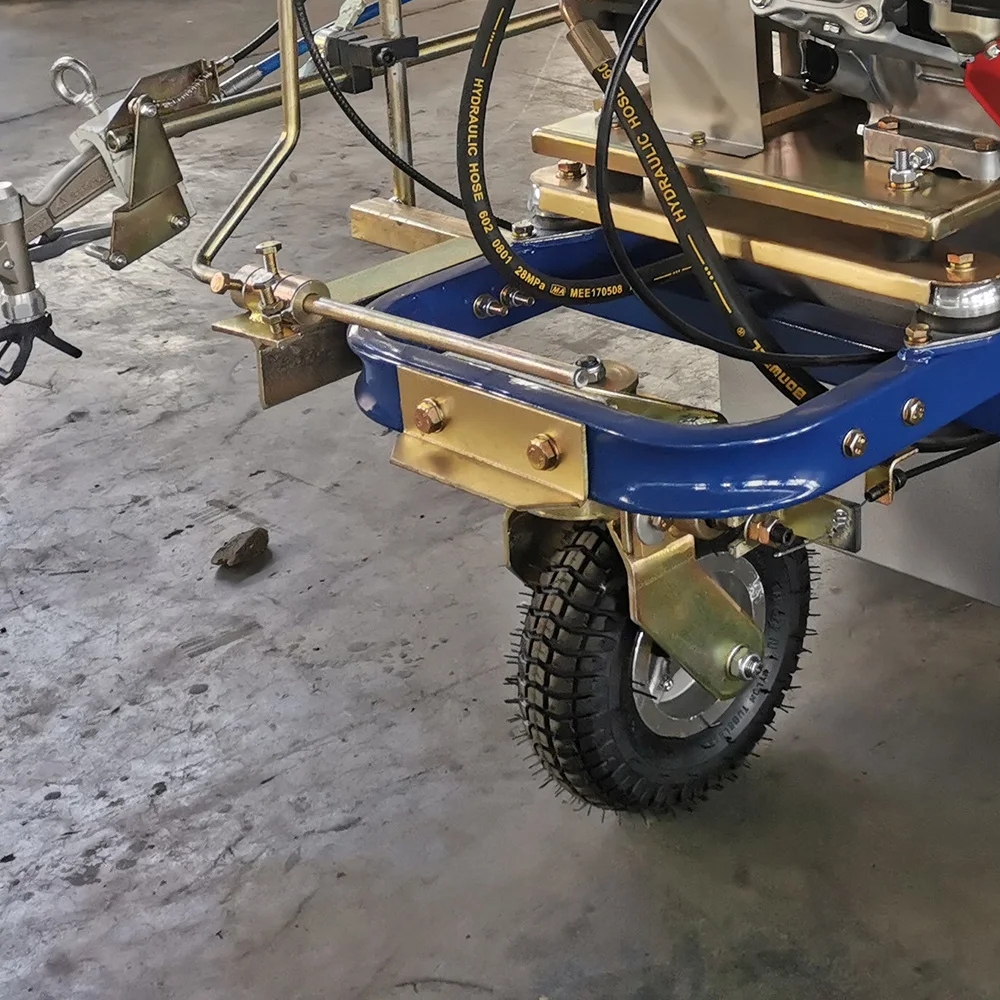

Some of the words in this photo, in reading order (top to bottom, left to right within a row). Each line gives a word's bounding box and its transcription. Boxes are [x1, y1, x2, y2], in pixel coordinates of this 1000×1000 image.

[467, 78, 485, 156] HYDRAULIC
[469, 163, 484, 202] HOSE
[636, 133, 687, 222] HYDRAULIC
[478, 210, 493, 234] 602
[492, 238, 513, 264] 0801
[514, 266, 546, 291] 28MPa
[570, 284, 623, 298] MEE170508
